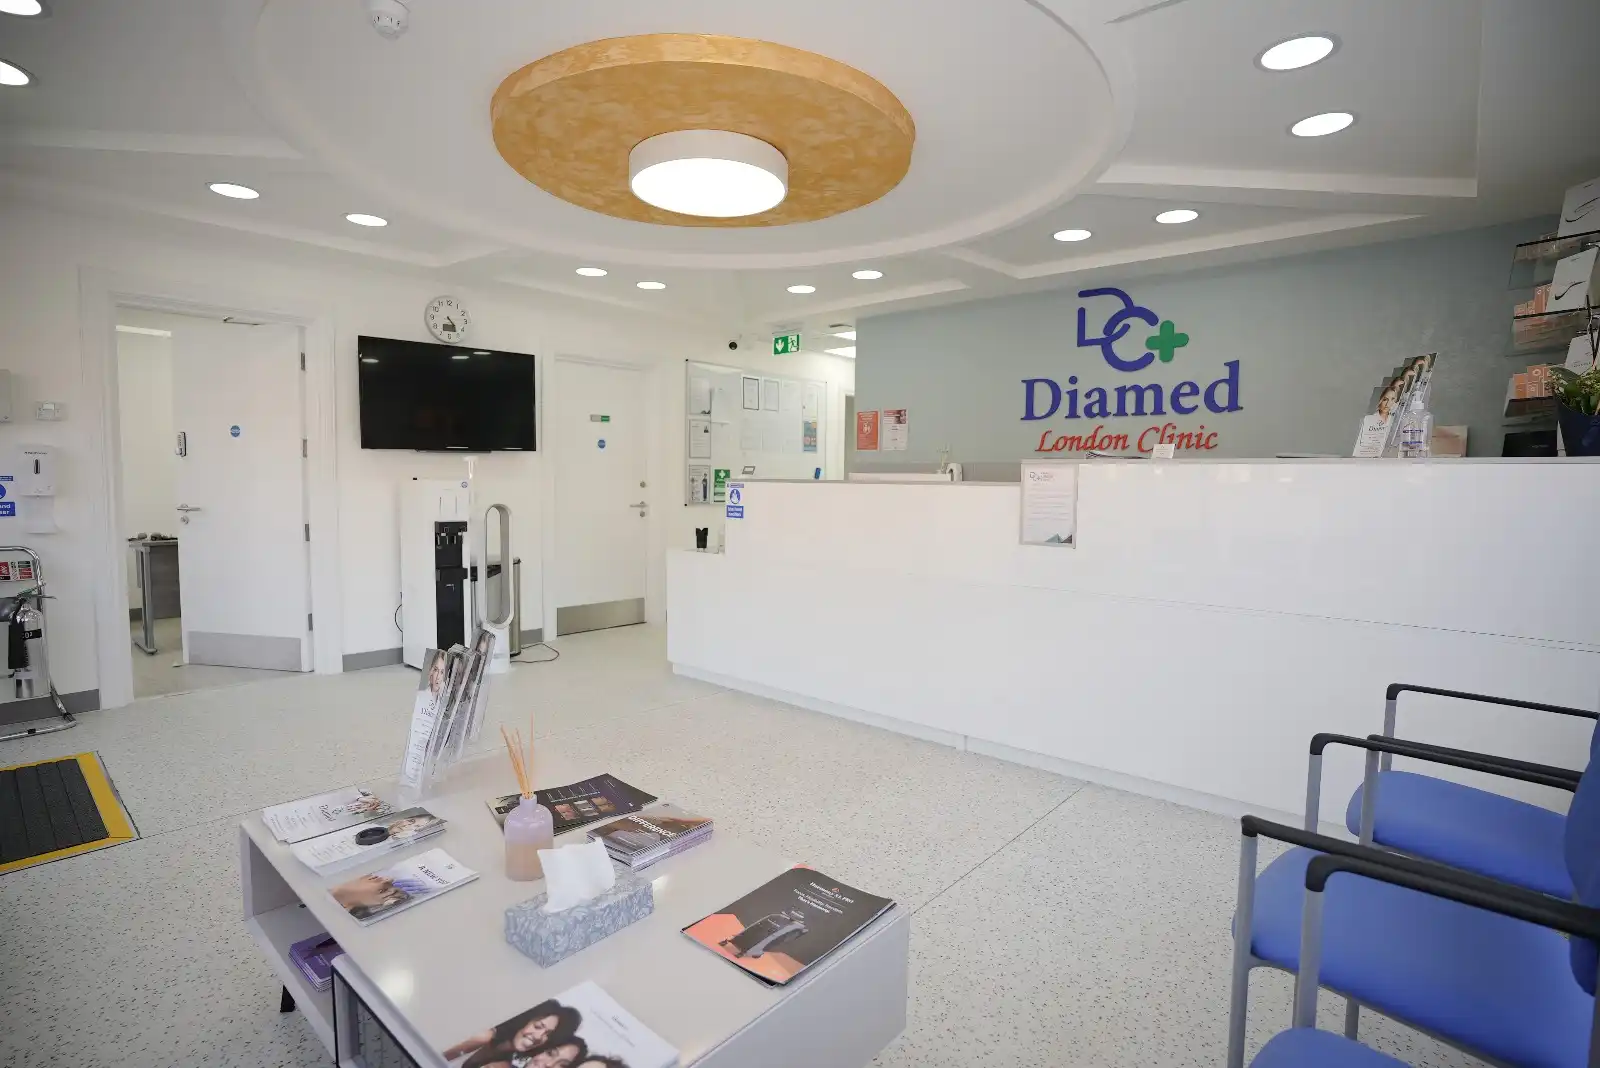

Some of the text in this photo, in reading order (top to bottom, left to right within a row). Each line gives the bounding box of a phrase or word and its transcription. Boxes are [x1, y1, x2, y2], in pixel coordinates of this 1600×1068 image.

[446, 299, 453, 307] 12
[430, 313, 435, 321] 9
[1020, 360, 1243, 421] Diamed
[1035, 425, 1129, 452] London
[1137, 423, 1218, 453] Clinic
